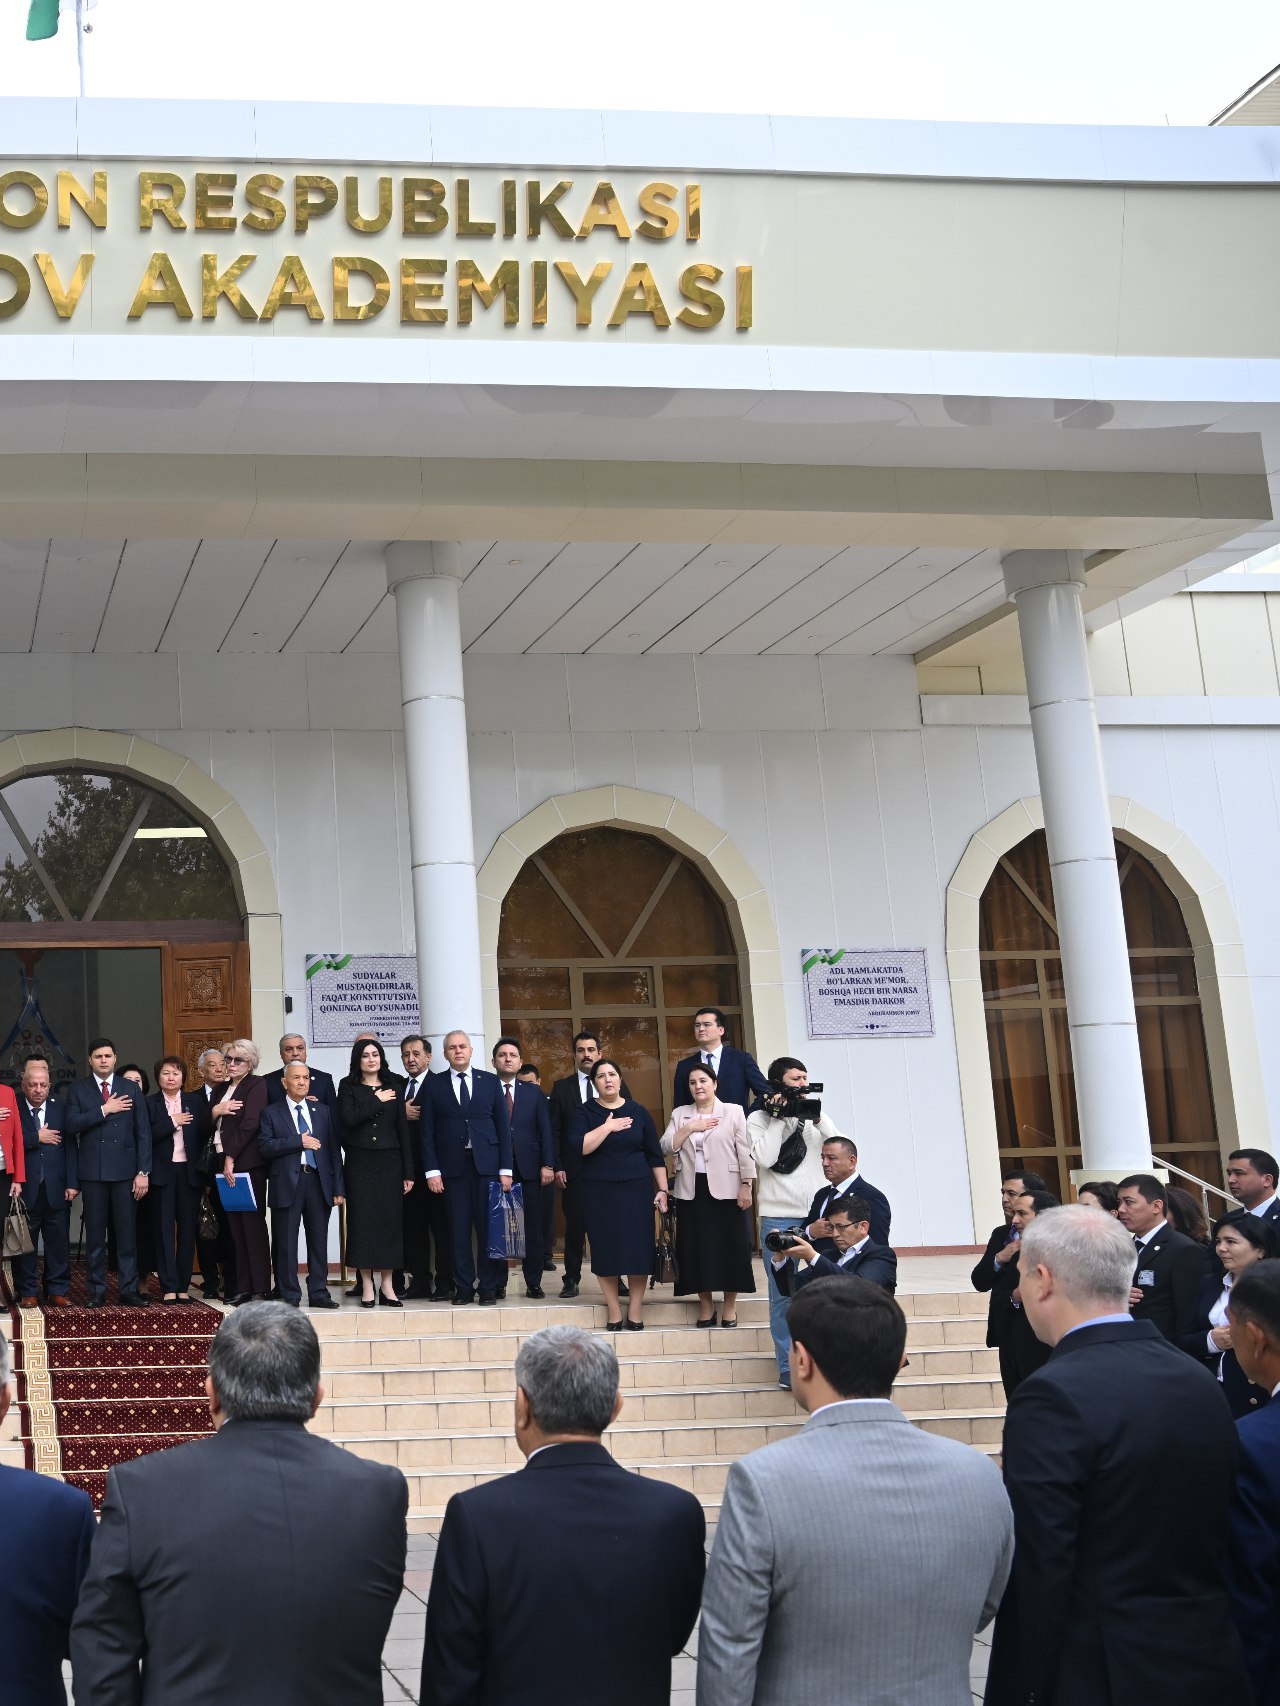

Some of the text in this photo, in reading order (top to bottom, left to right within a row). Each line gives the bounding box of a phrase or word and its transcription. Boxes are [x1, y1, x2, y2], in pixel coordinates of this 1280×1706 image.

[138, 171, 702, 242] RESPUBLIKASI
[127, 253, 752, 330] AKADEMIYASI
[830, 966, 903, 975] ADL MAMLAKATDA
[352, 972, 396, 980] SUDYALAR
[336, 982, 413, 991] MUSTAQILDIRLAR,
[819, 988, 851, 996] BOSHQA
[876, 987, 890, 995] BIR
[321, 992, 417, 1002] FAQAT KONSTITUTSIYA
[834, 997, 905, 1006] EMASDIR DARKOR
[320, 1004, 362, 1013] QONUNGA
